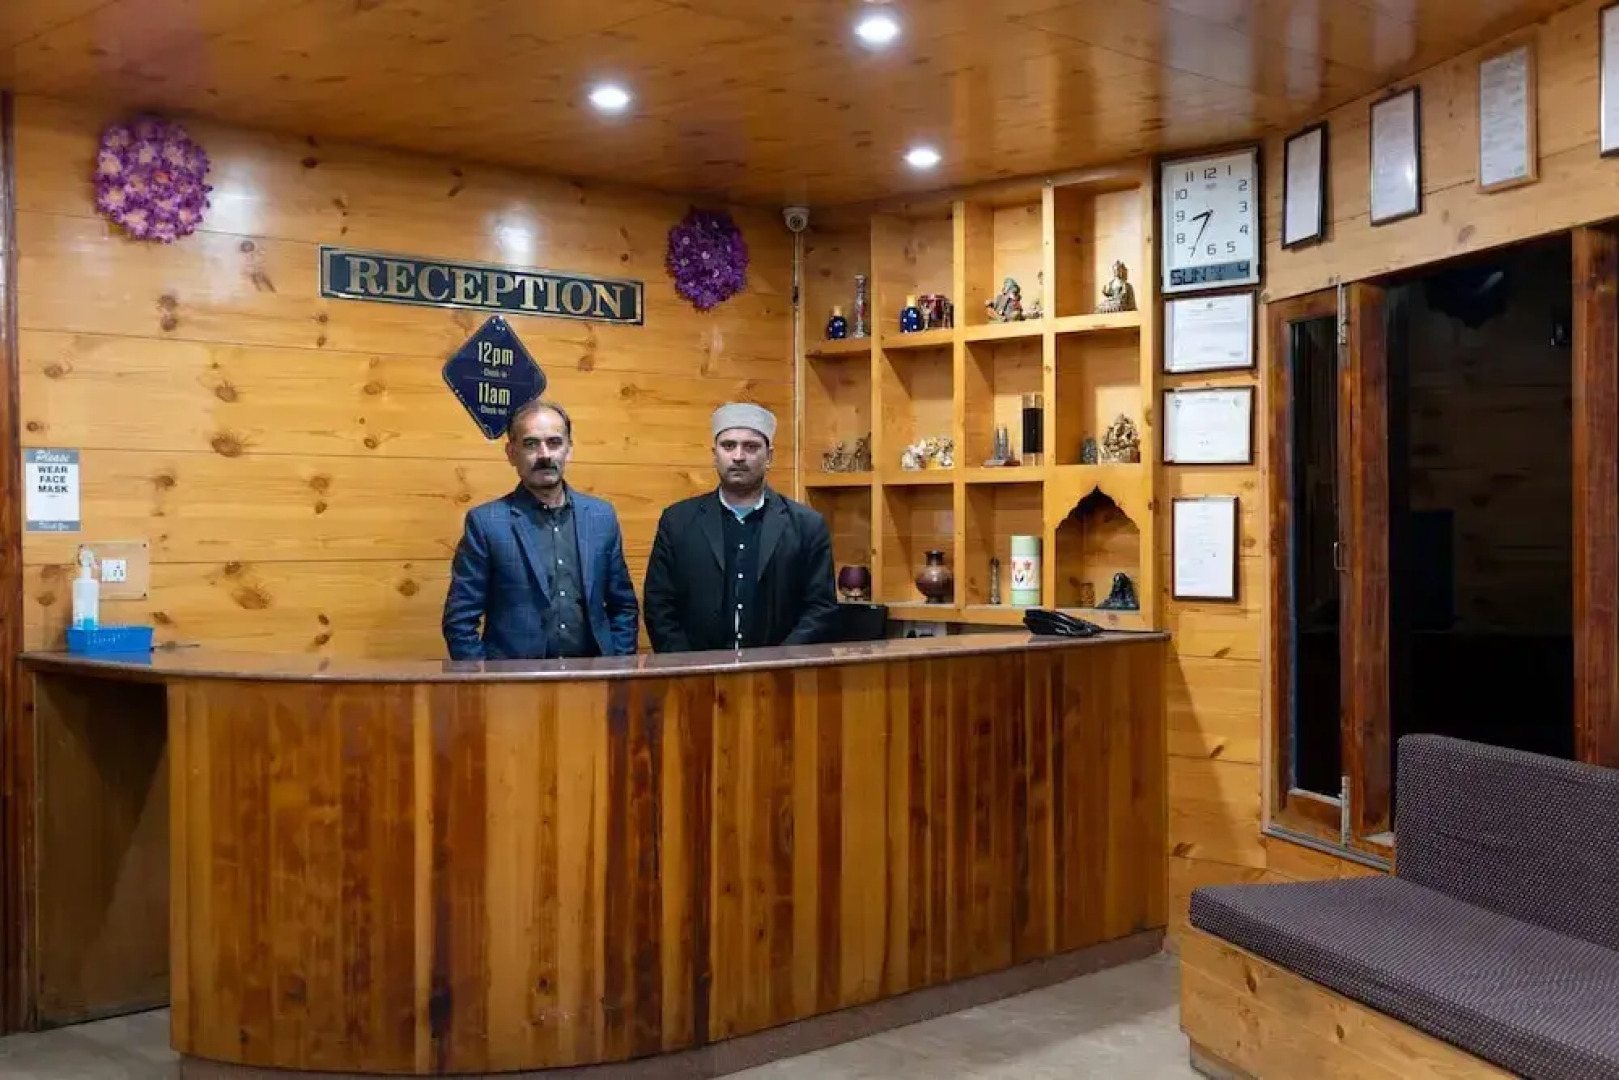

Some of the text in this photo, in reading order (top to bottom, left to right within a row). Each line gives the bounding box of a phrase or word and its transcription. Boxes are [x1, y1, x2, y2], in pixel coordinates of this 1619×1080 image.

[1185, 170, 1194, 183] 11
[1204, 167, 1217, 180] 12
[1238, 179, 1248, 192] 2
[1175, 188, 1188, 200] 10
[1239, 201, 1248, 213] 3
[1176, 210, 1186, 222] 9
[1239, 224, 1249, 236] 4
[1176, 232, 1186, 244] 8
[1207, 244, 1217, 255] 6
[1226, 241, 1237, 253] 5
[1170, 267, 1206, 286] SUN
[345, 255, 625, 318] RECEPTION
[478, 341, 514, 367] 12pm
[478, 382, 511, 406] 11am
[39, 475, 67, 483] FACE
[38, 485, 69, 493] MASK
